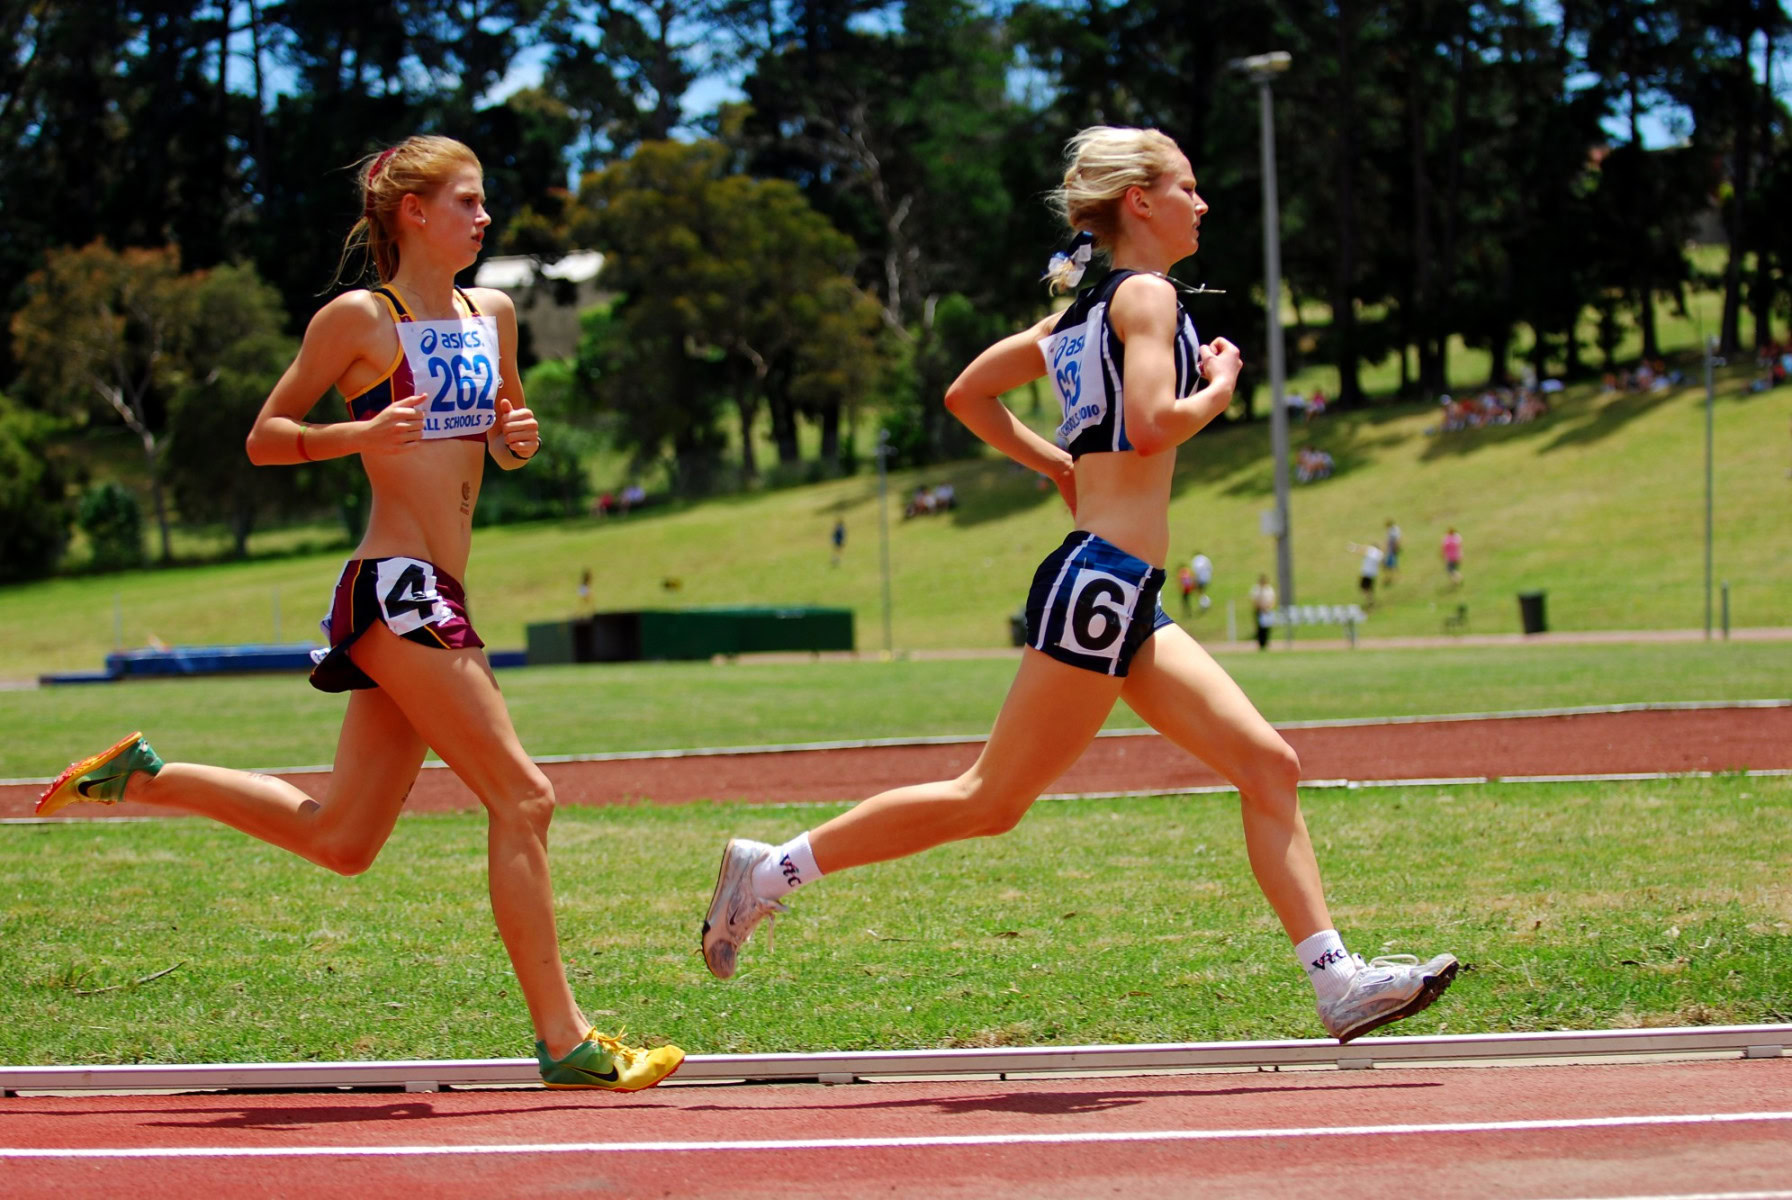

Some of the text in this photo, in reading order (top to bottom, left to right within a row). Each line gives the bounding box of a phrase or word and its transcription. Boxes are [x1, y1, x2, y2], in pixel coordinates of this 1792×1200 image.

[441, 331, 482, 349] asics
[428, 354, 494, 412] 262
[423, 418, 440, 431] LL
[444, 414, 482, 430] SCHOOLS
[385, 564, 439, 620] 4
[1072, 578, 1125, 651] 6
